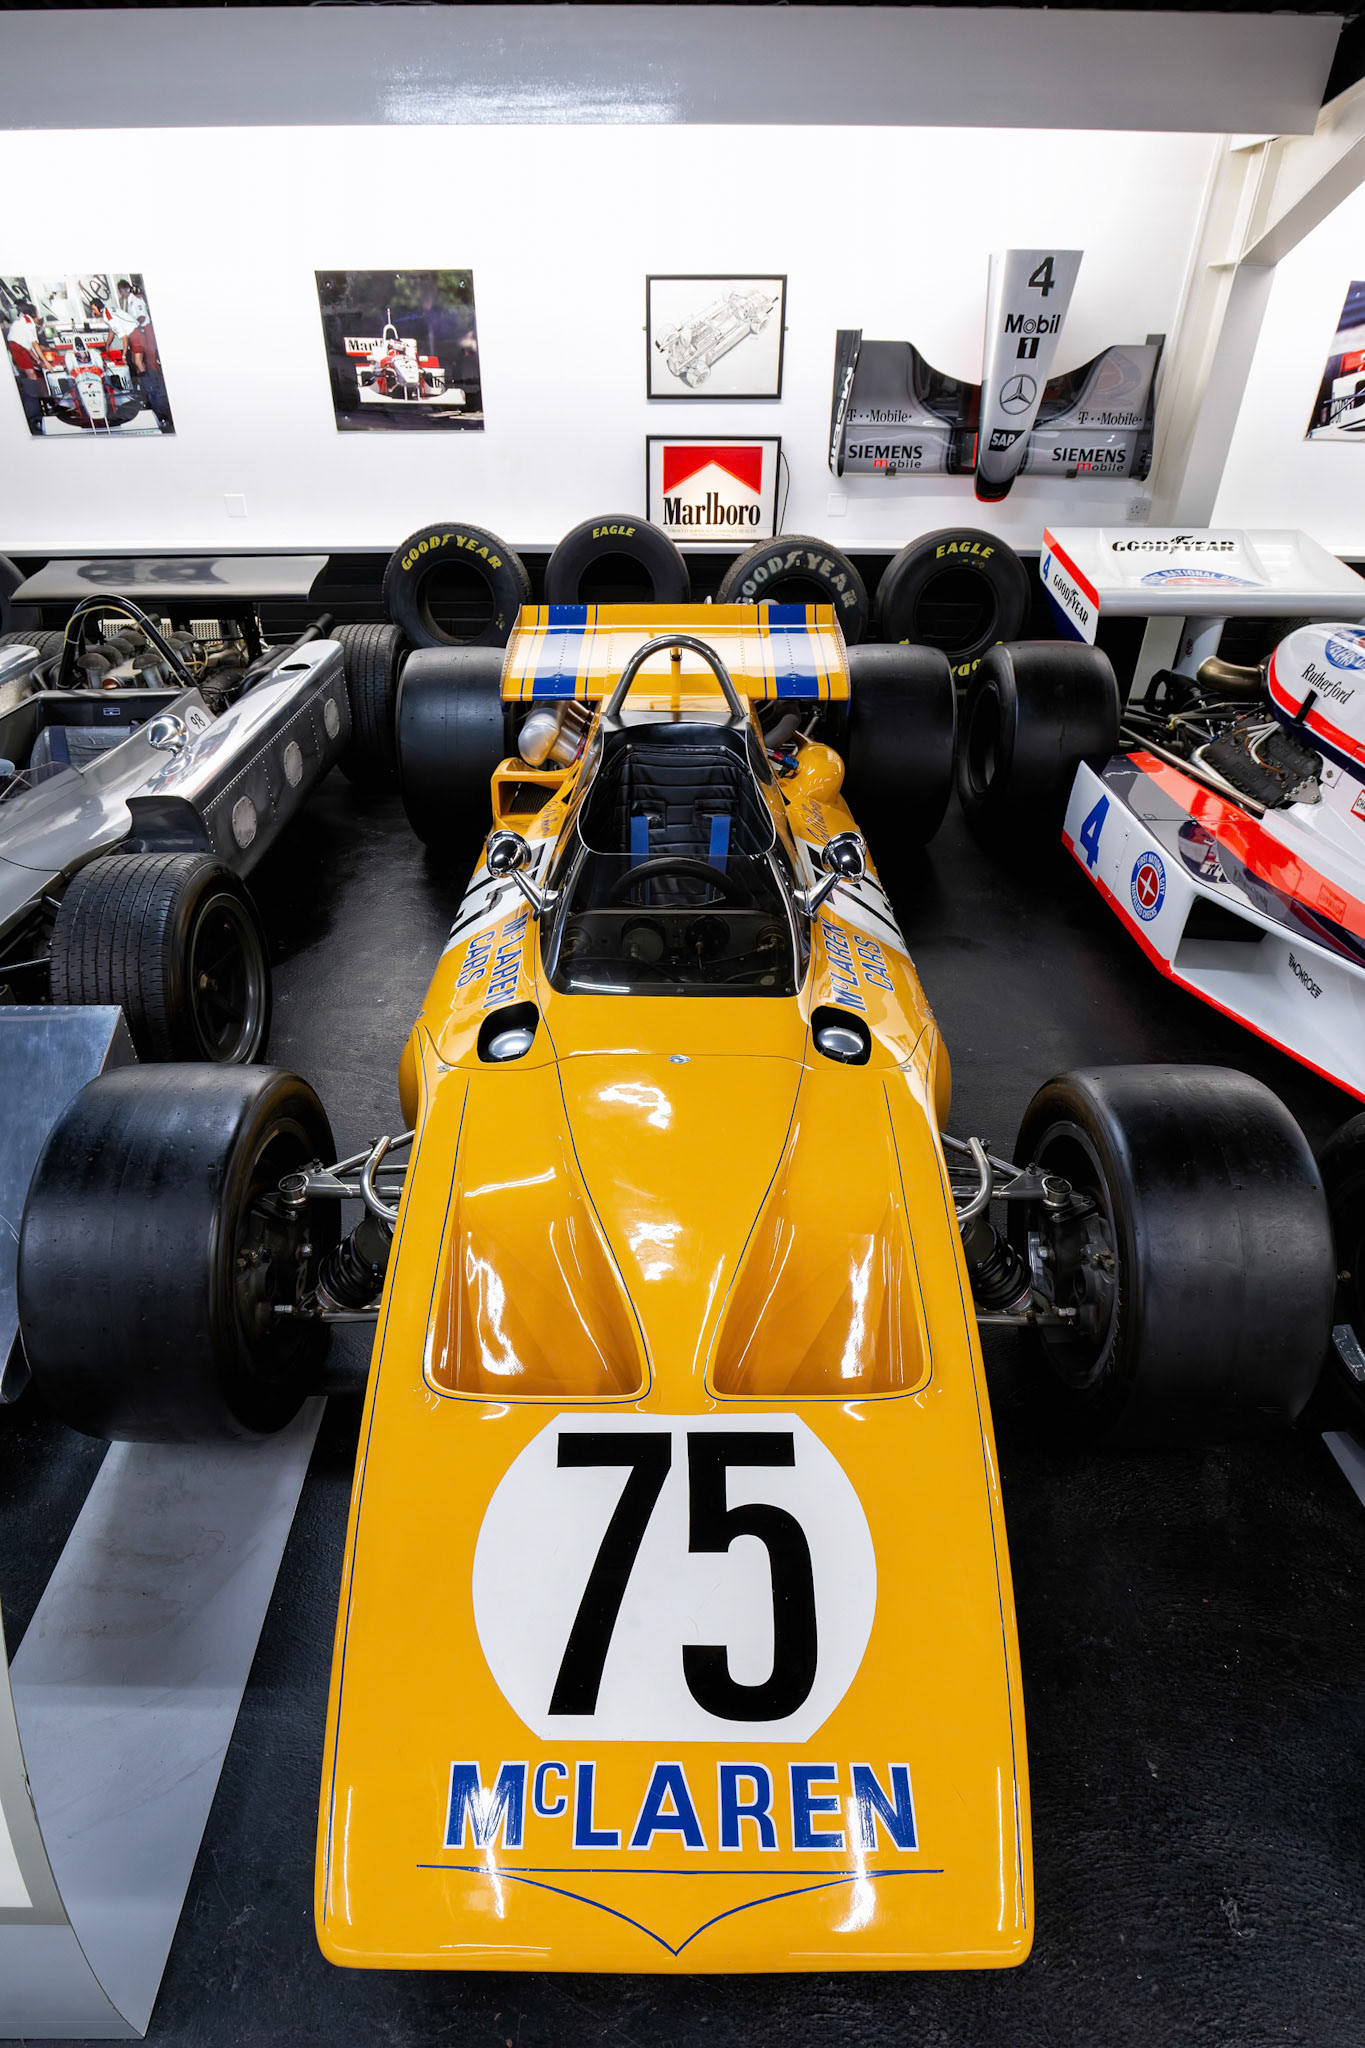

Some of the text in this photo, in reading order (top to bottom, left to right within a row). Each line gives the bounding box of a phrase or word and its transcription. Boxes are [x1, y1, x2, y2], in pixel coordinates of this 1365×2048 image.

[1028, 256, 1055, 297] 4
[1004, 314, 1061, 334] Mobil
[848, 445, 922, 459] SIEMENS
[991, 432, 1015, 447] SAP
[1052, 447, 1126, 463] SIEMENS
[873, 458, 922, 469] mobile
[1076, 462, 1124, 473] mobile
[663, 492, 760, 525] Marlboro
[592, 525, 636, 539] EAGLE
[1112, 537, 1236, 553] GOODYEAR
[401, 533, 502, 571] GOODYEAR
[936, 541, 995, 559] EAGLE
[1042, 554, 1051, 580] 4
[1053, 574, 1089, 627] GOODYEAR
[1300, 662, 1355, 705] Rutherford
[190, 713, 206, 730] 98
[1080, 794, 1110, 870] 4
[456, 930, 496, 988] CARS
[482, 911, 530, 1009] McLAREN
[820, 916, 867, 1012] McLAREN
[854, 935, 894, 992] CARS
[1289, 951, 1323, 999] MONROE
[548, 1432, 818, 1722] 75
[443, 1761, 919, 1852] McLAREN
